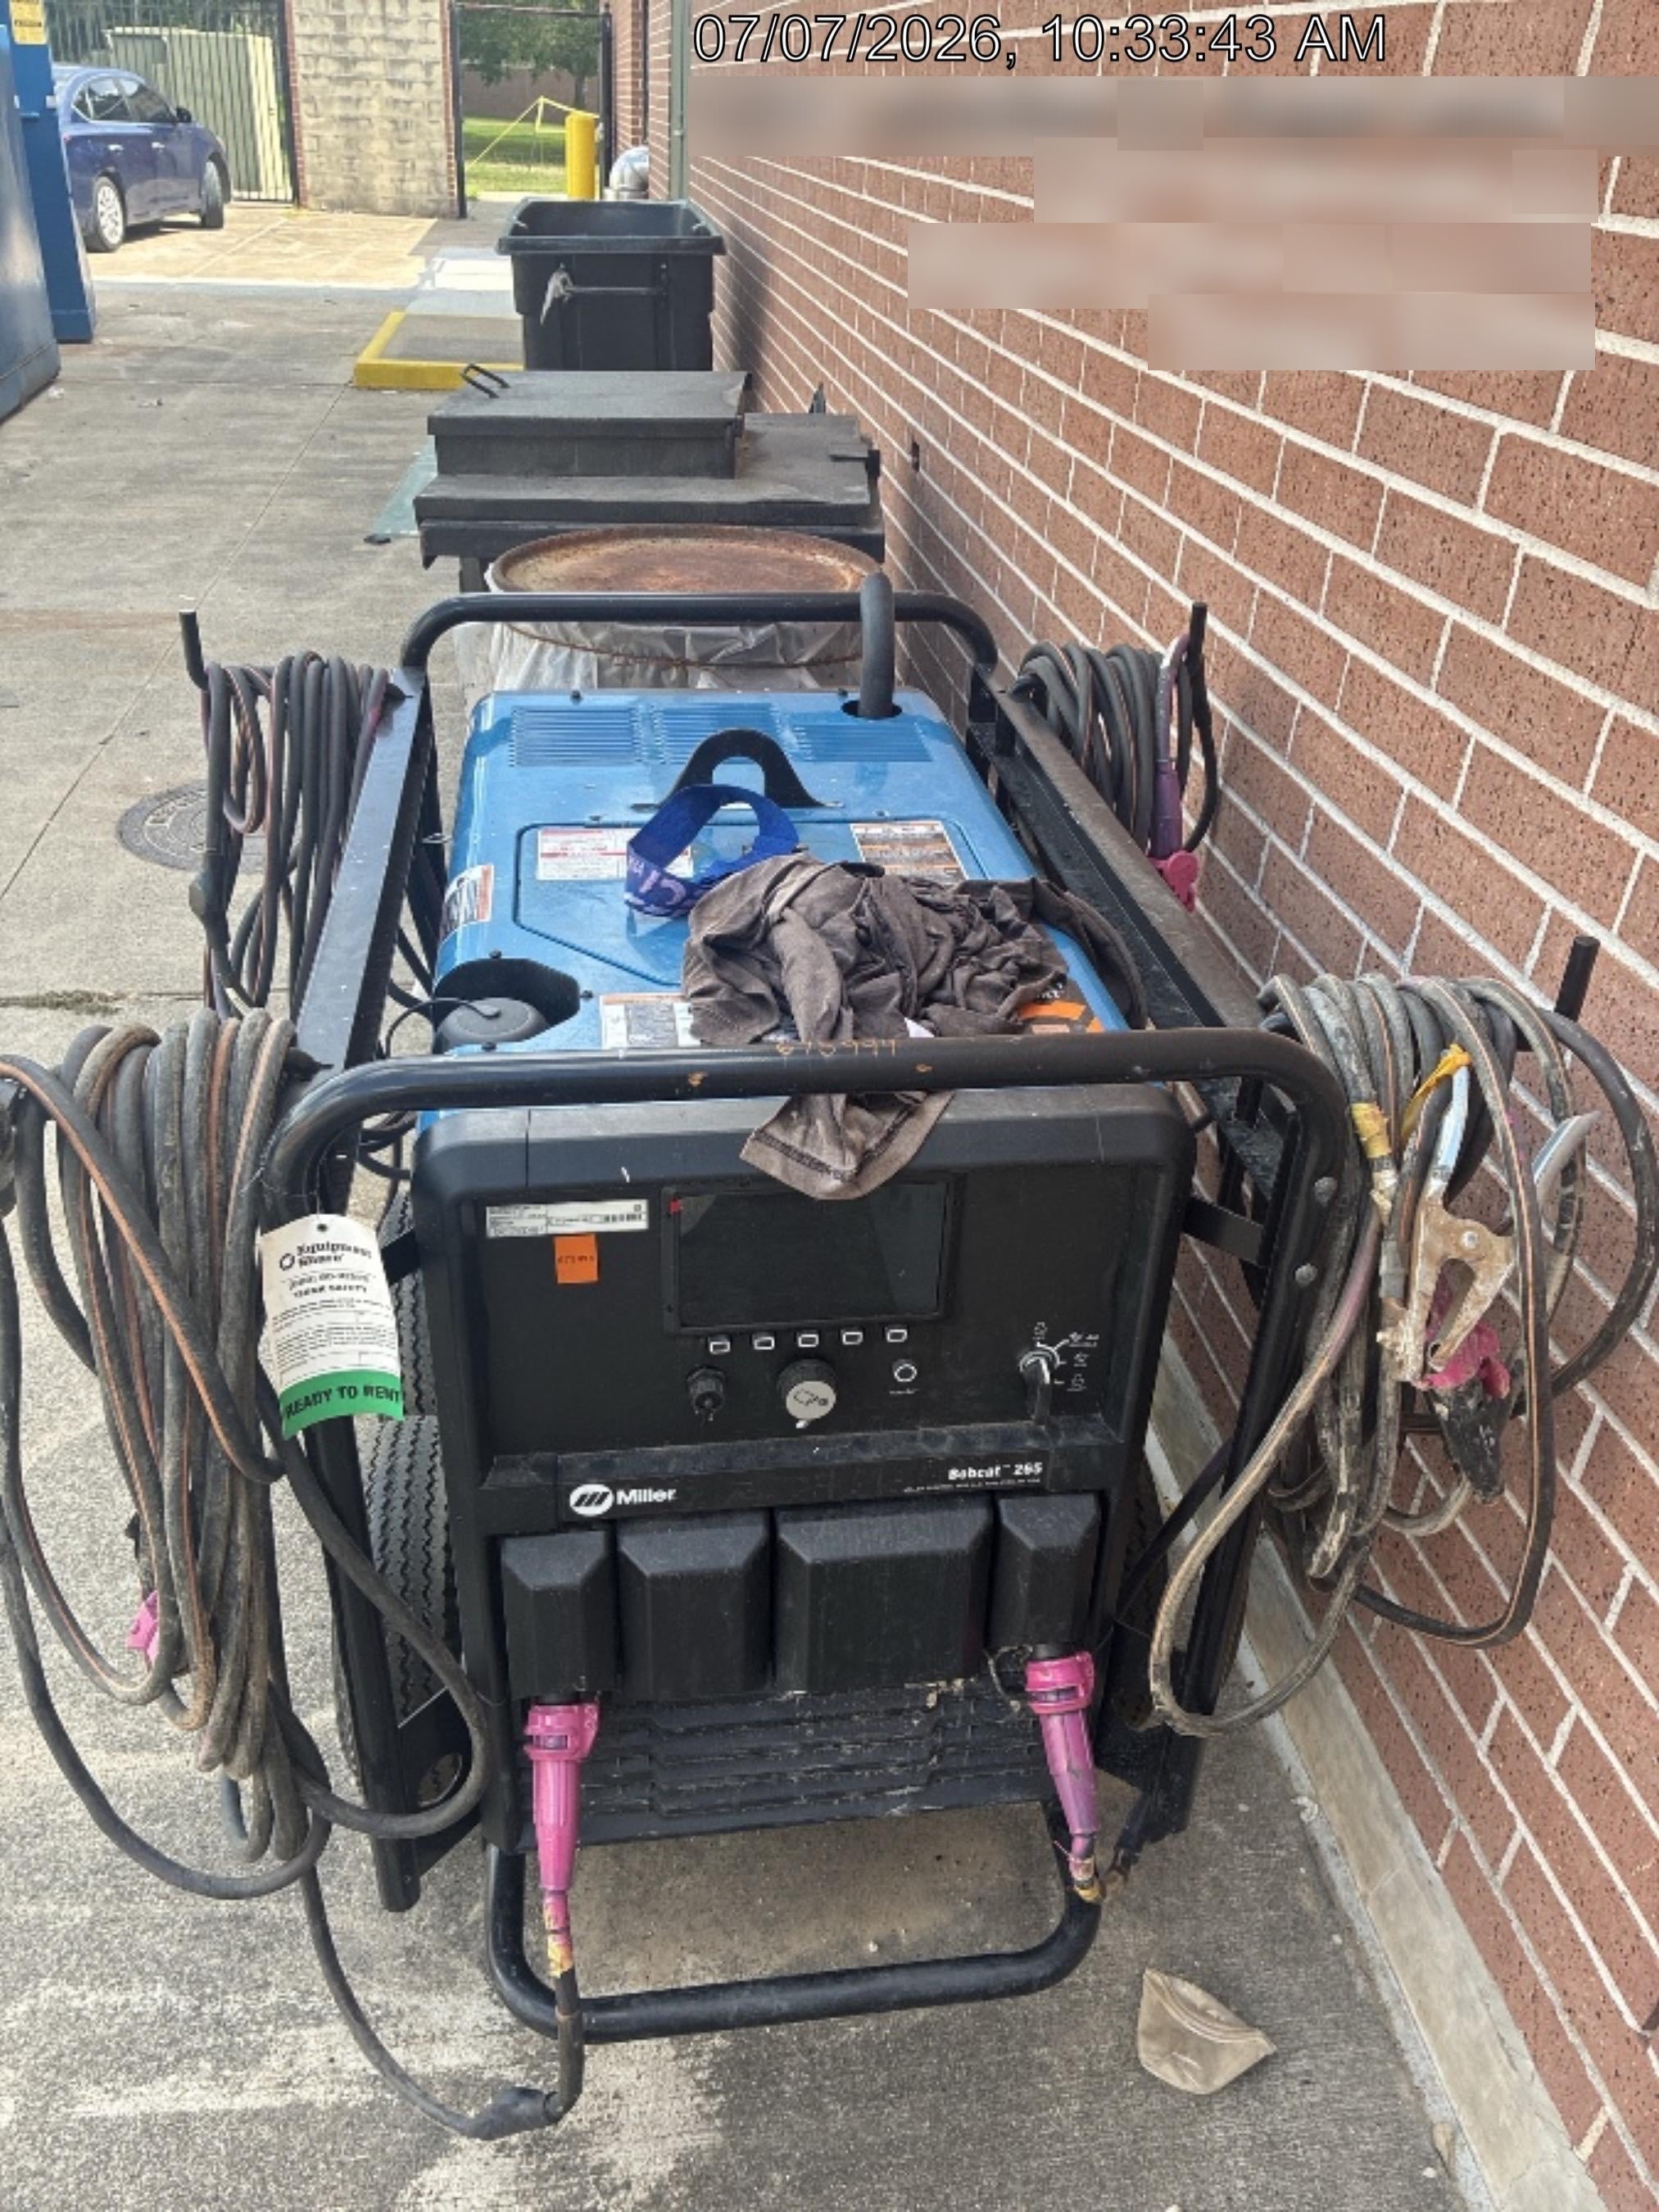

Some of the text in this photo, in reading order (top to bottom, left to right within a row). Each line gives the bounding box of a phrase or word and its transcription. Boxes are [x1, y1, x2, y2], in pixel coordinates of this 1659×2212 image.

[284, 1385, 400, 1420] READY TO RENT
[616, 1487, 677, 1505] Miller
